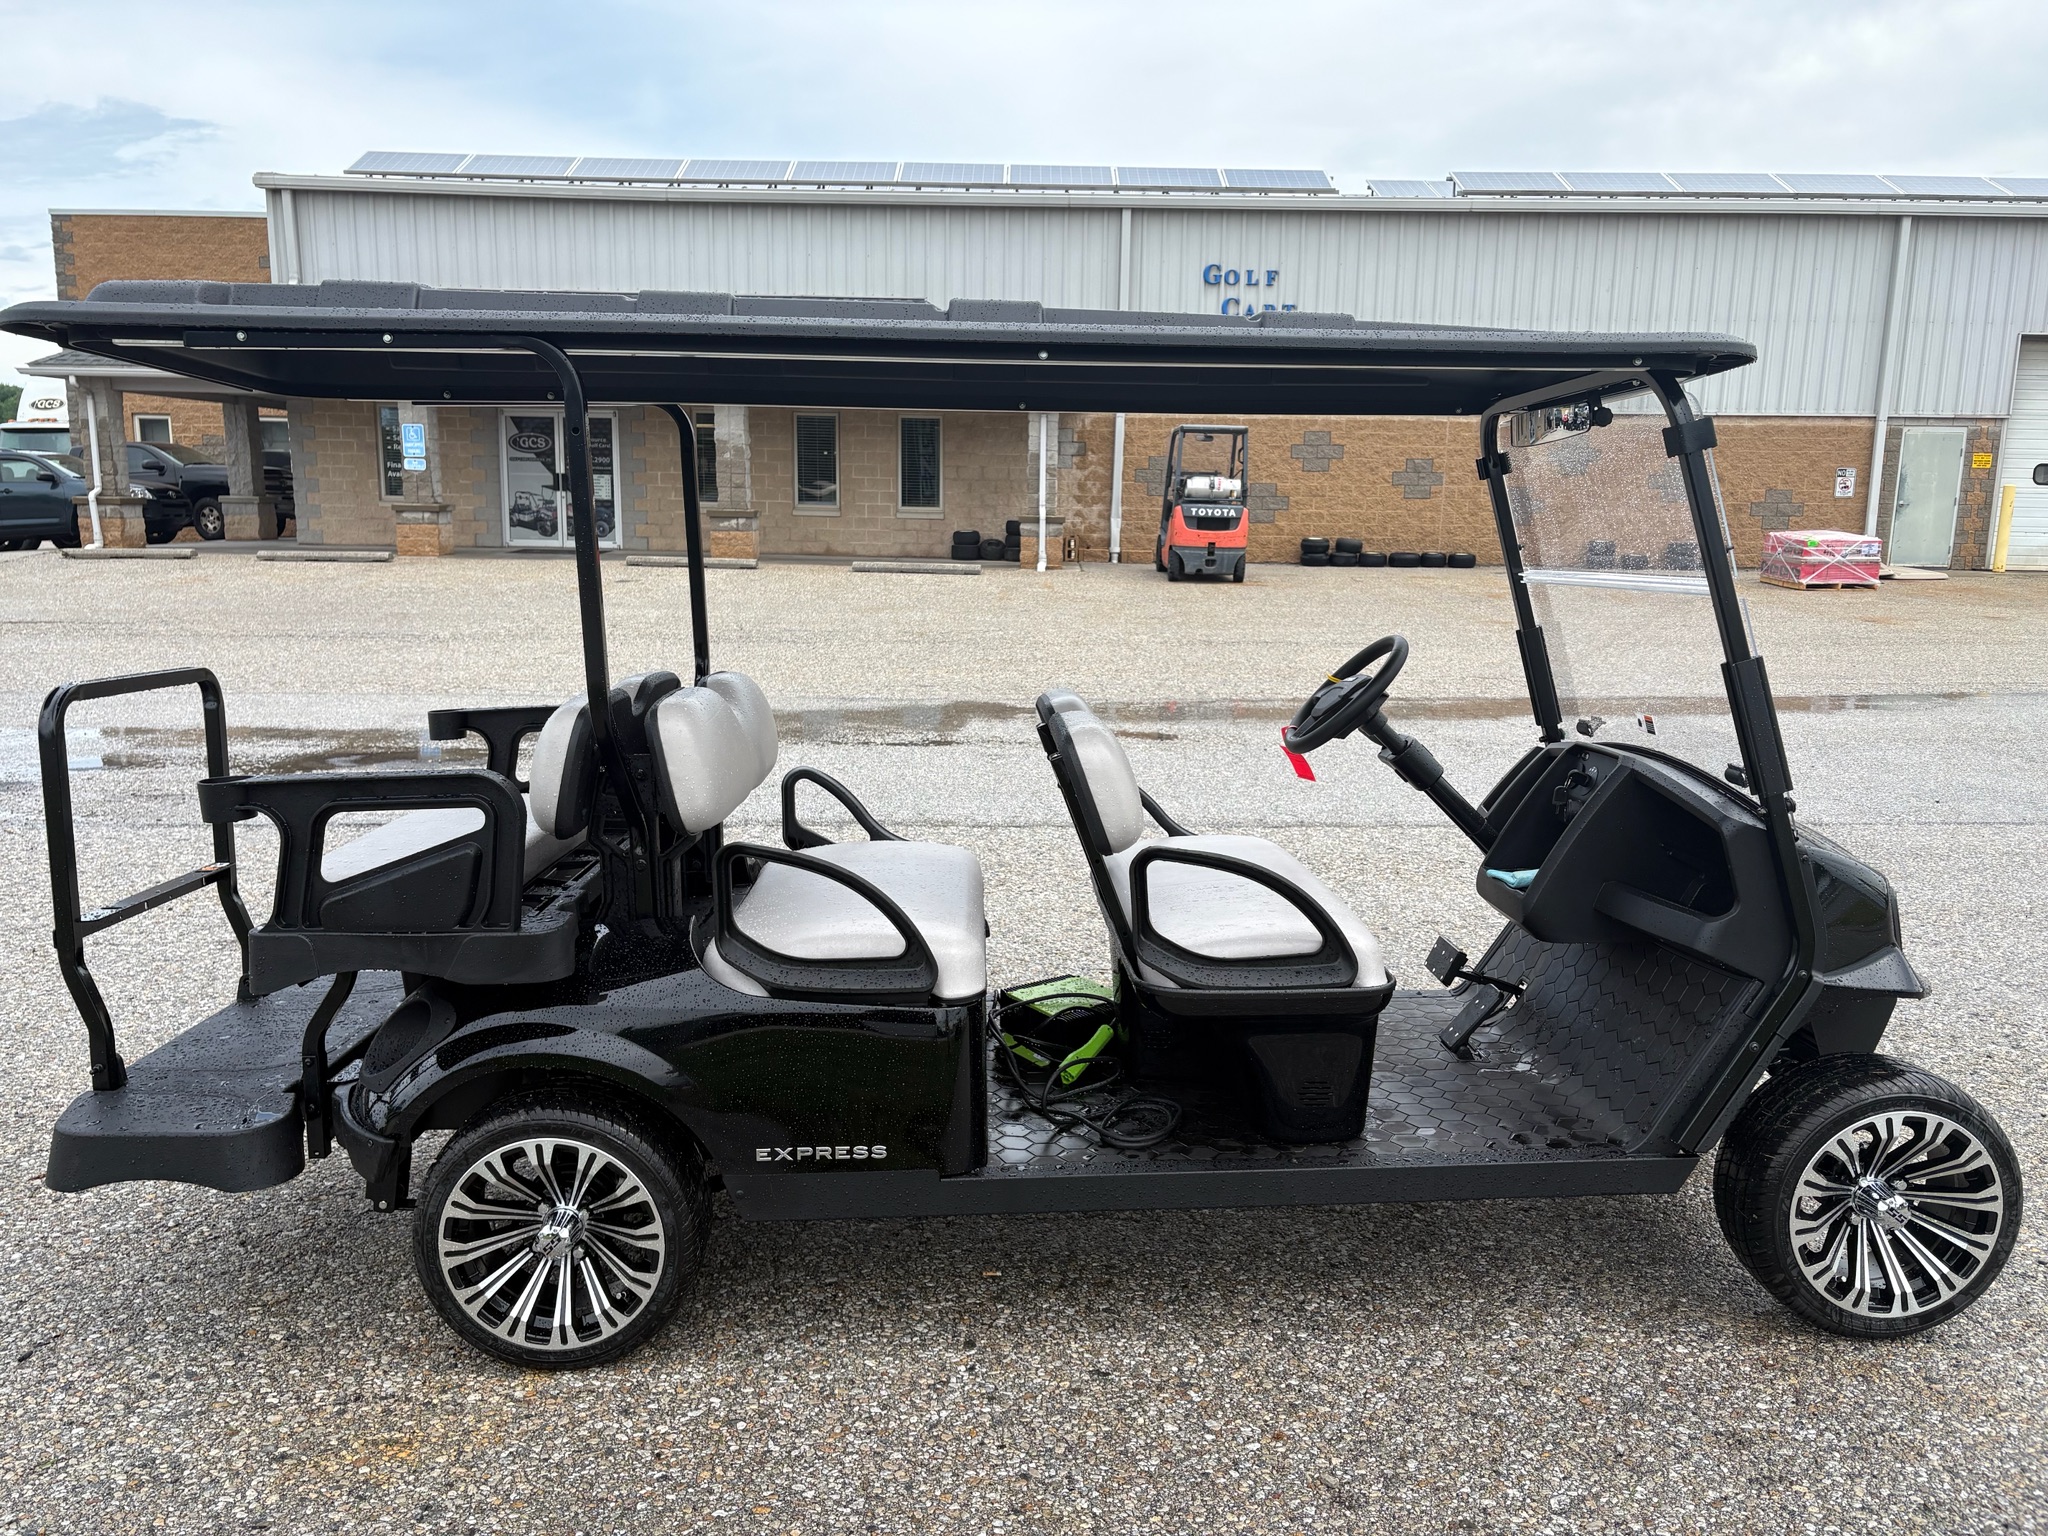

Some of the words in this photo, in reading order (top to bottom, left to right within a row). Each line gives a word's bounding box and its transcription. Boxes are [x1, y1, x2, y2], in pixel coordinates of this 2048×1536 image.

[1203, 263, 1279, 287] GOLF
[519, 436, 546, 449] GCS
[1190, 507, 1236, 517] TOYOTA
[755, 1145, 888, 1162] EXPRESS
